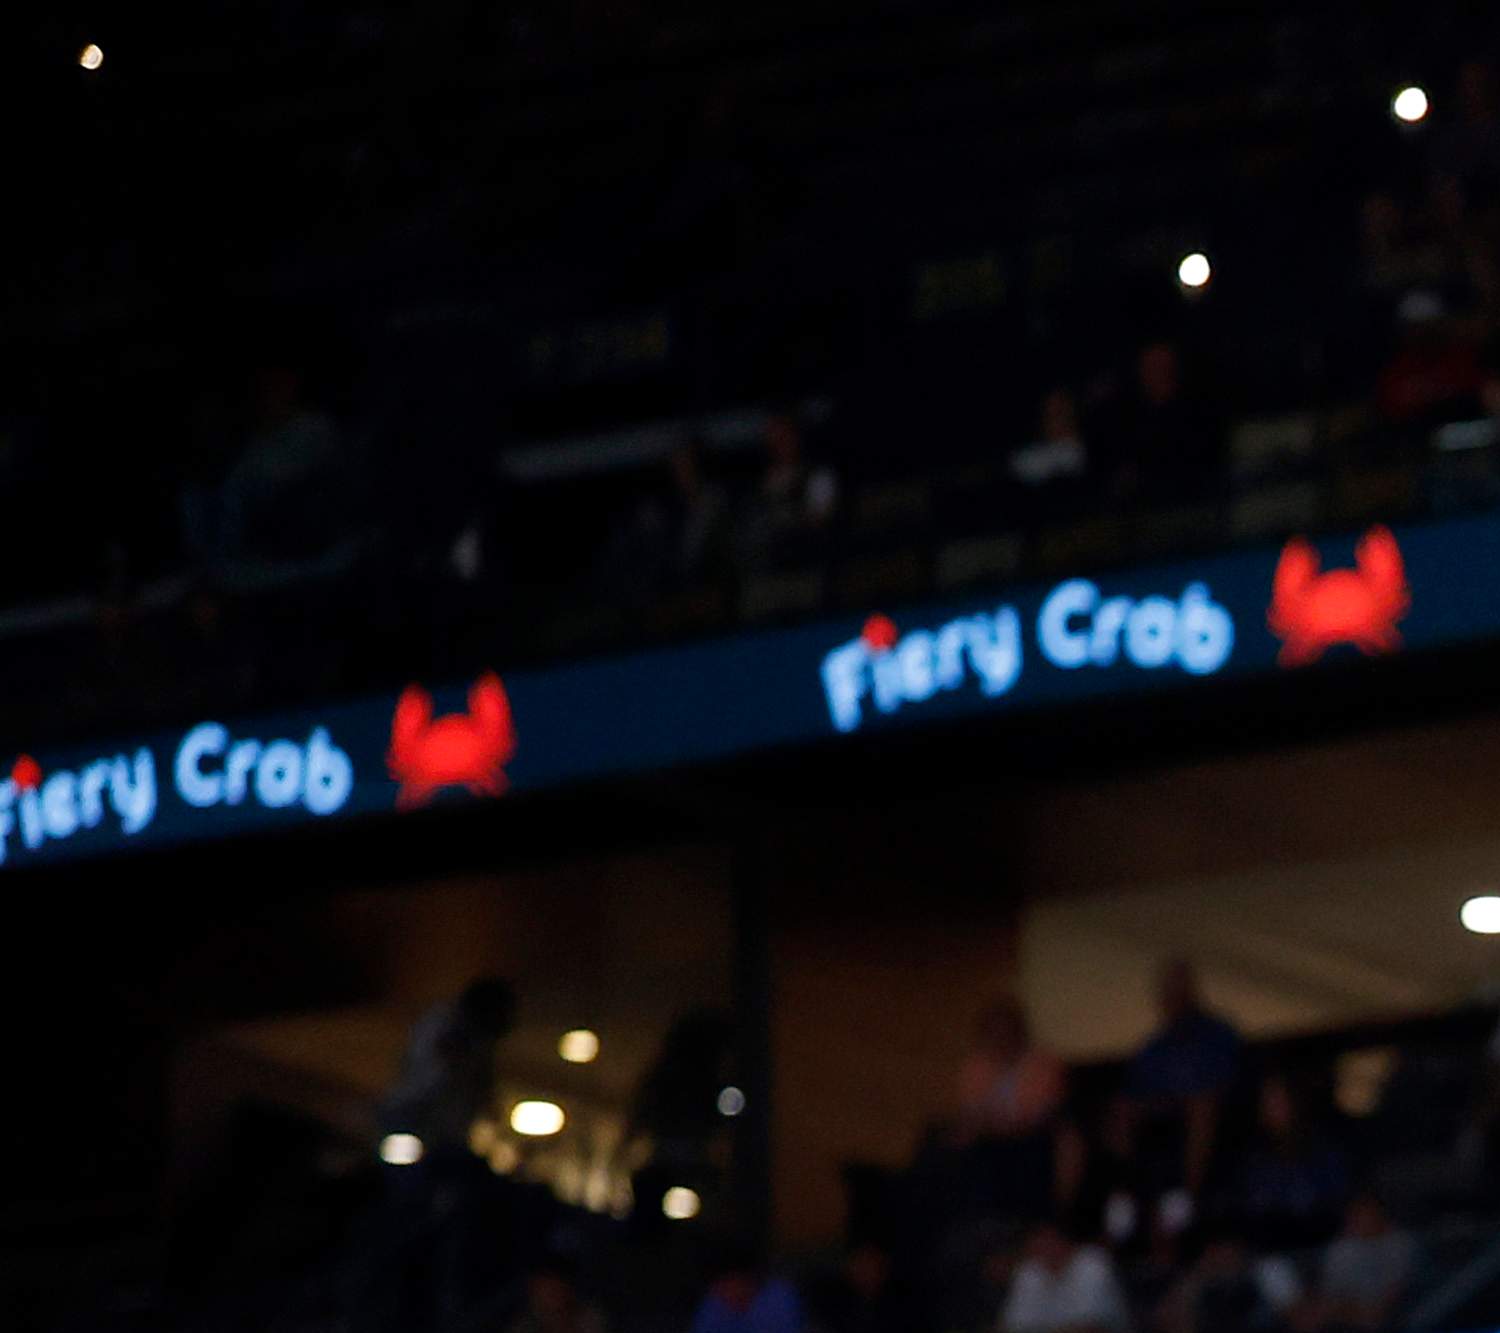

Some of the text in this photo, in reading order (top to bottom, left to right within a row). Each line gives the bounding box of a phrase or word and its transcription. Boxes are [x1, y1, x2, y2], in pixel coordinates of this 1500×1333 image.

[824, 580, 1231, 730] Fiery Crab
[175, 725, 352, 815] Crab
